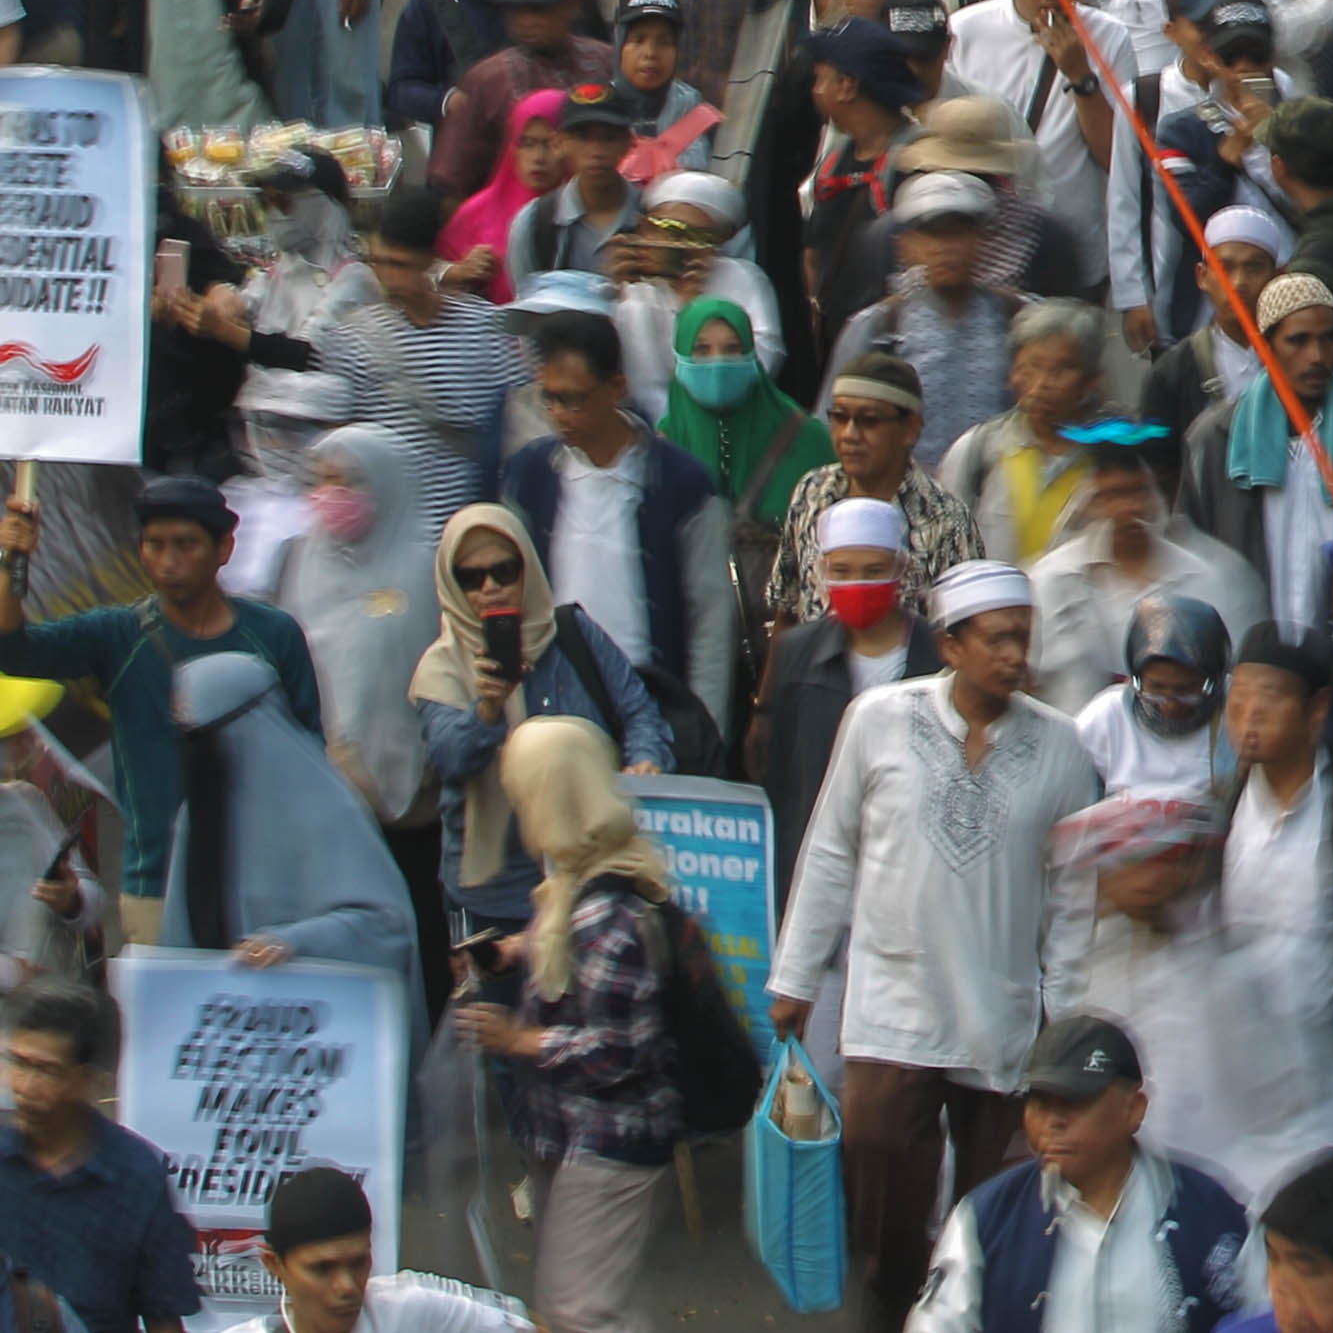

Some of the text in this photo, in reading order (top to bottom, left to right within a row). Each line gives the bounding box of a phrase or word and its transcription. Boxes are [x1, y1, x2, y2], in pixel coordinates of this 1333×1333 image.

[44, 397, 106, 416] RAKYAT
[172, 1040, 350, 1082] ELECTION
[195, 1084, 325, 1122] MAKES
